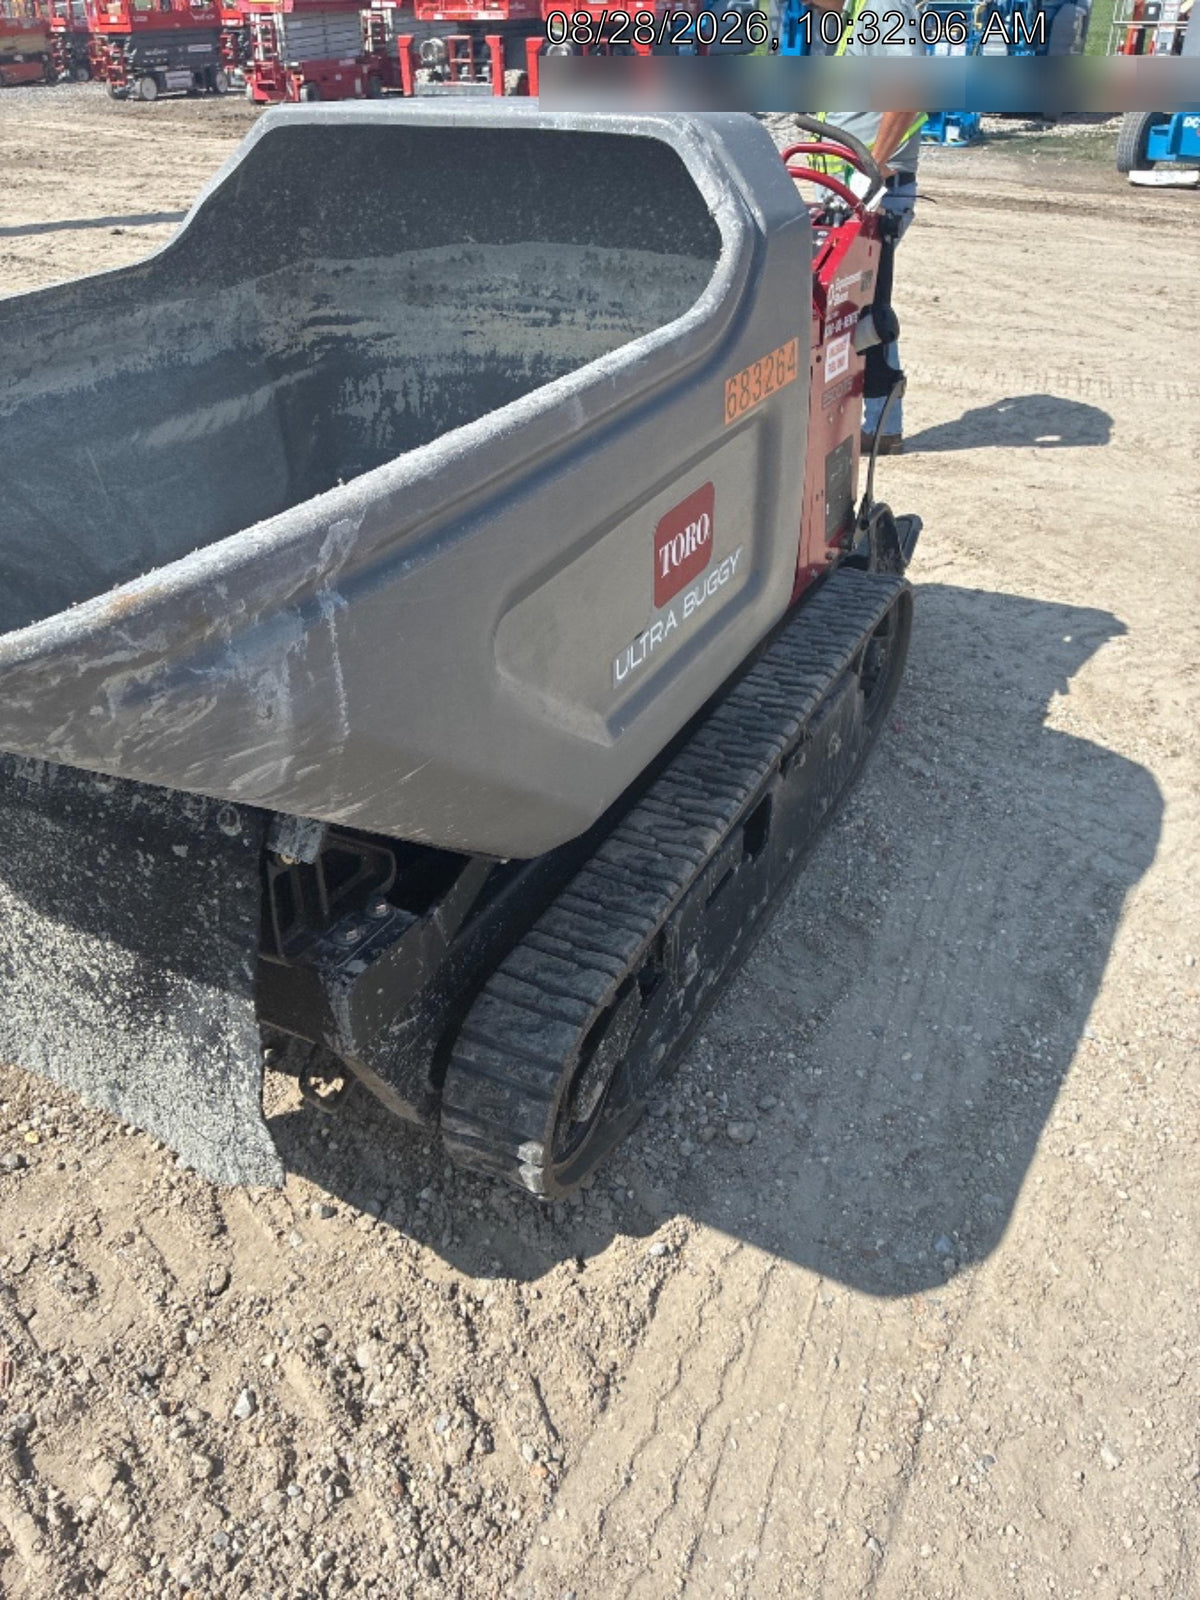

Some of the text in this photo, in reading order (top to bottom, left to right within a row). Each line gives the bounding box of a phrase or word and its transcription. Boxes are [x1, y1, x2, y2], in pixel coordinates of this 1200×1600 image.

[727, 341, 796, 418] 683264
[659, 513, 711, 578] TORO
[616, 548, 742, 680] ULTRA BUGGY
